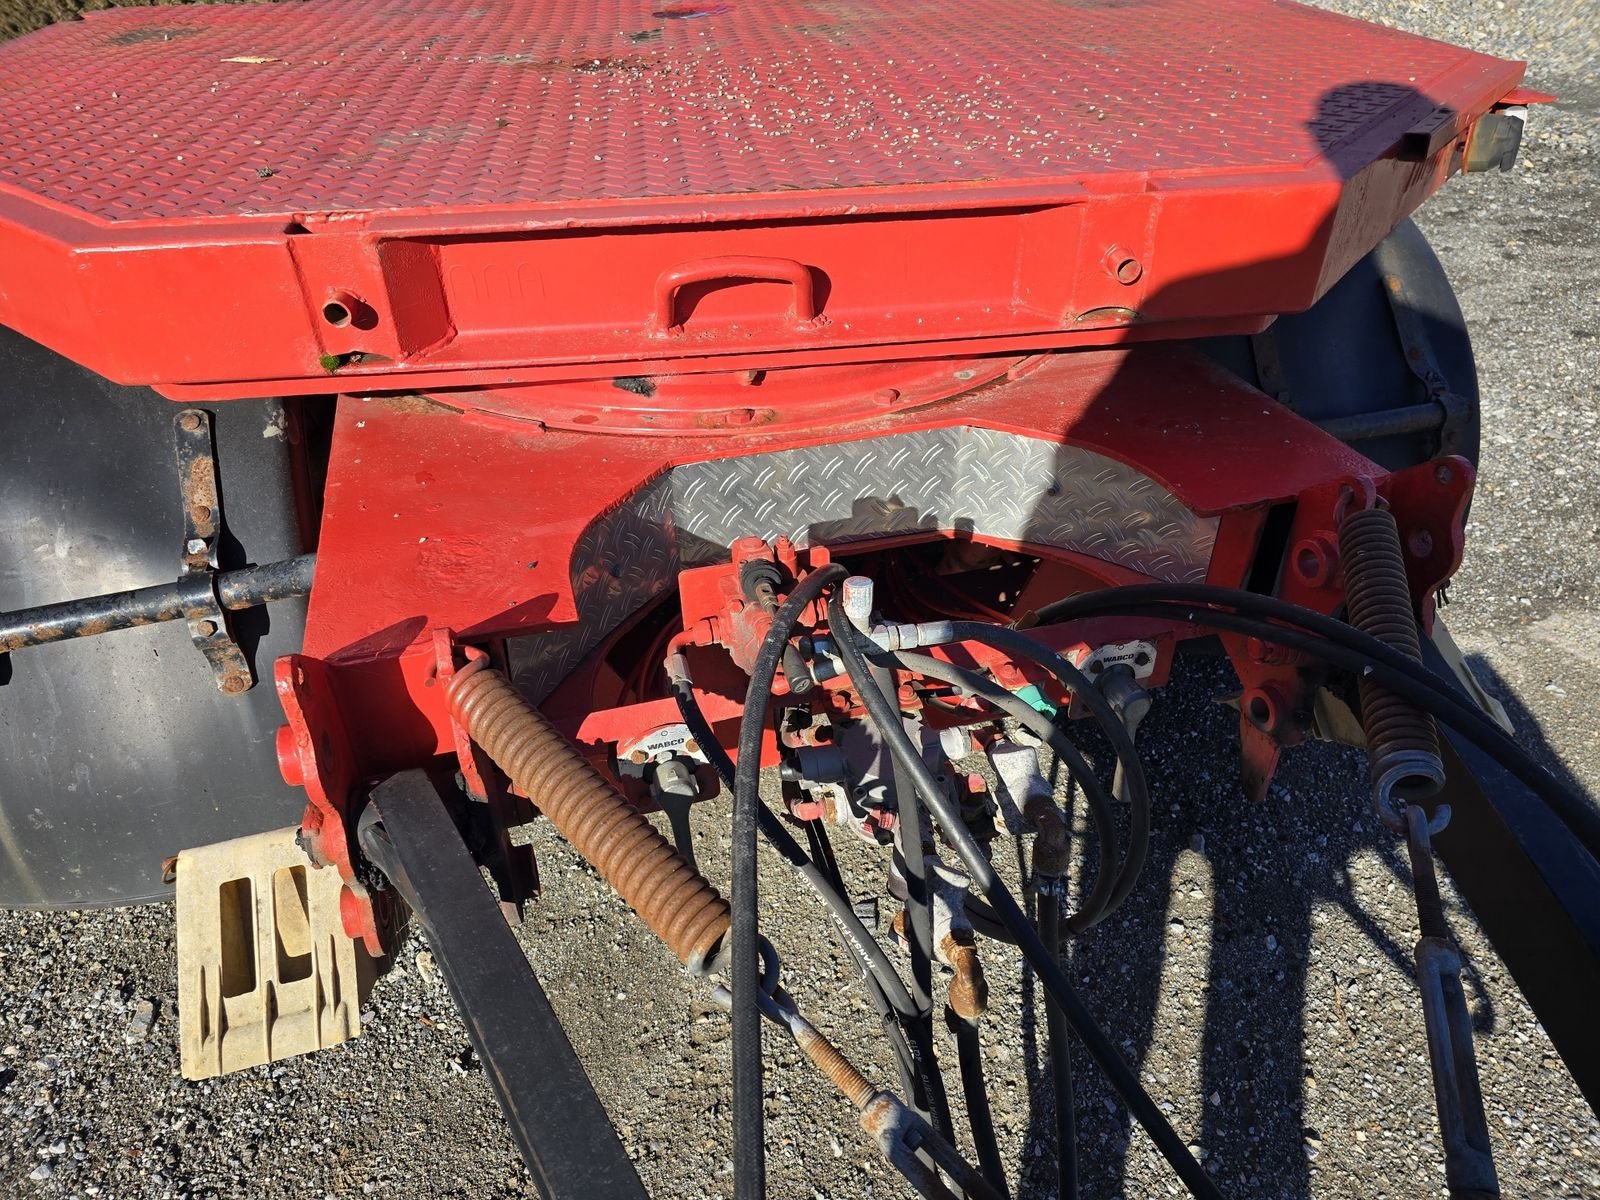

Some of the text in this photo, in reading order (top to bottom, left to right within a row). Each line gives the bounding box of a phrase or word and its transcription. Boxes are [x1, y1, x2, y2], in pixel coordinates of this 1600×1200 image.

[1103, 653, 1135, 663] WABCO
[647, 737, 685, 751] WABCO
[815, 894, 828, 907] KP
[831, 912, 875, 968] HANSA-FLEX
